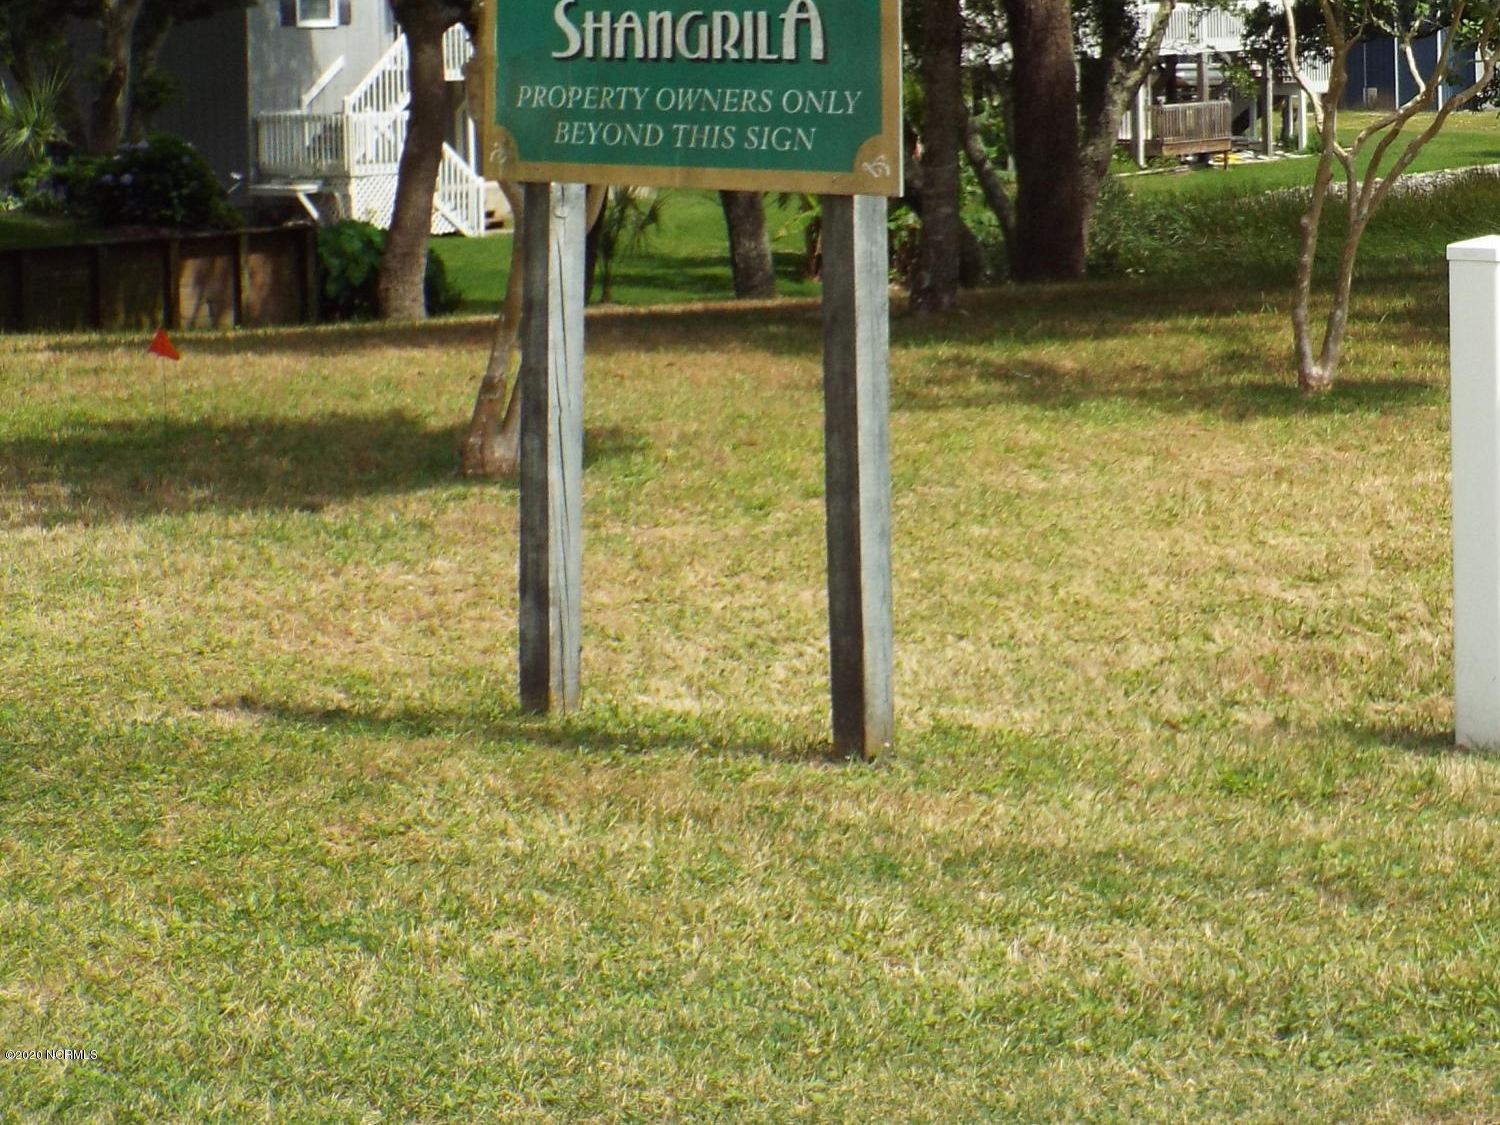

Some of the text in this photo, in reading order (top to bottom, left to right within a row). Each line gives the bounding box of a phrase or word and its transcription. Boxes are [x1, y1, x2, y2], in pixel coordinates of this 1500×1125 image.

[516, 85, 862, 115] PROPERTY OWNERS ONLY
[554, 121, 817, 151] BEYOND THIS SIGN
